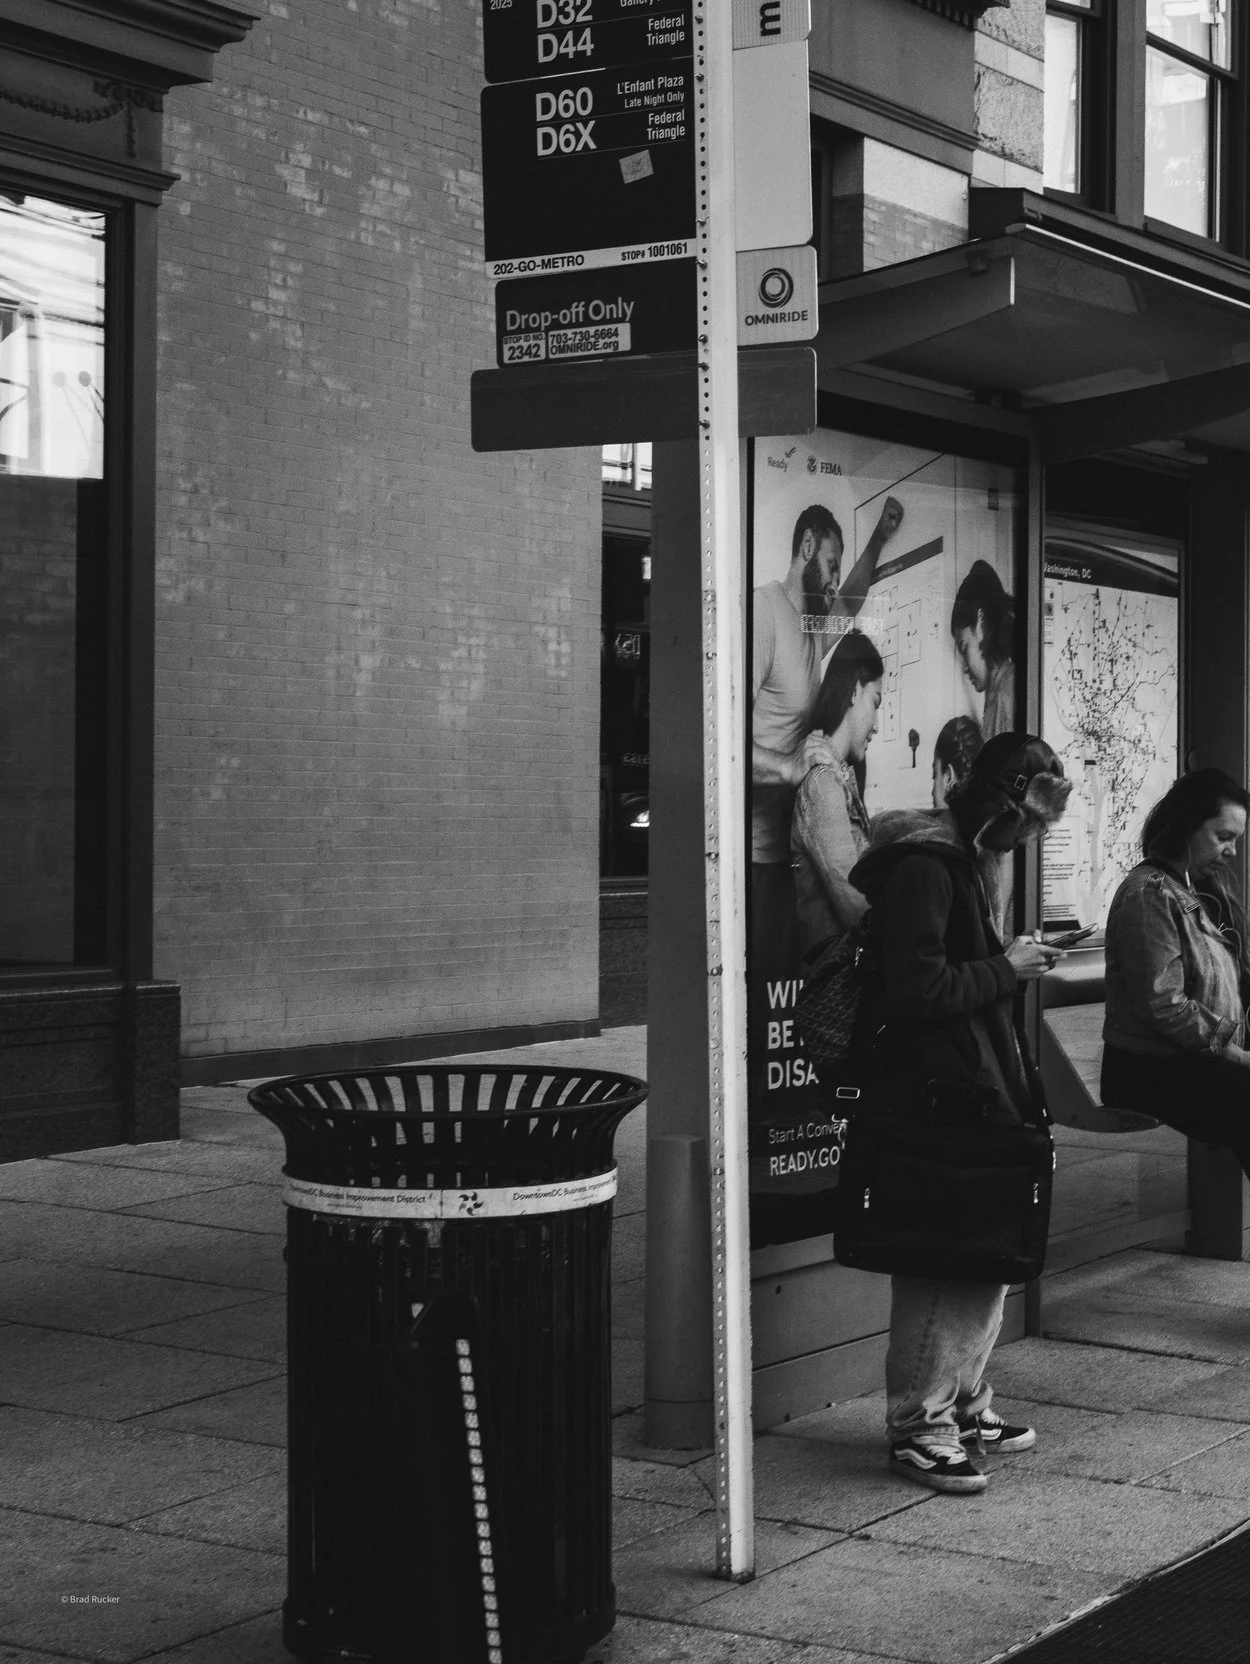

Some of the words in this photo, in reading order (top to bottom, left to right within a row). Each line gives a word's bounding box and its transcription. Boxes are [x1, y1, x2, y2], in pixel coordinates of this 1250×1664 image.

[536, 0, 593, 28] D32
[648, 14, 684, 31] Federal
[537, 28, 594, 63] D44
[646, 30, 685, 46] Triangle
[617, 78, 654, 95] L'Enfant
[658, 75, 684, 89] Plaza
[535, 87, 593, 121] D60
[624, 97, 642, 108] Late
[644, 93, 665, 106] Night
[667, 91, 685, 103] Only
[648, 108, 685, 125] Federal
[537, 120, 597, 156] D6X
[646, 124, 686, 140] Triangle
[621, 248, 646, 262] STOP#
[649, 242, 688, 259] 1001061
[493, 254, 585, 275] 202-GO-METRO
[506, 301, 585, 333] Drop-off
[588, 296, 635, 322] Only
[744, 310, 809, 326] OMNIRIDE
[550, 327, 619, 345] 703-730-6664
[508, 343, 541, 361] 2342
[550, 339, 619, 355] OMNIRIDE.org
[768, 456, 788, 472] Ready
[820, 461, 842, 476] FEMA
[1082, 567, 1092, 579] DC
[767, 1019, 794, 1050] BE
[769, 1127, 795, 1144] Start
[796, 1123, 805, 1140] A
[769, 1145, 841, 1176] READY.GO
[346, 1192, 395, 1203] Improvement
[396, 1194, 427, 1203] District
